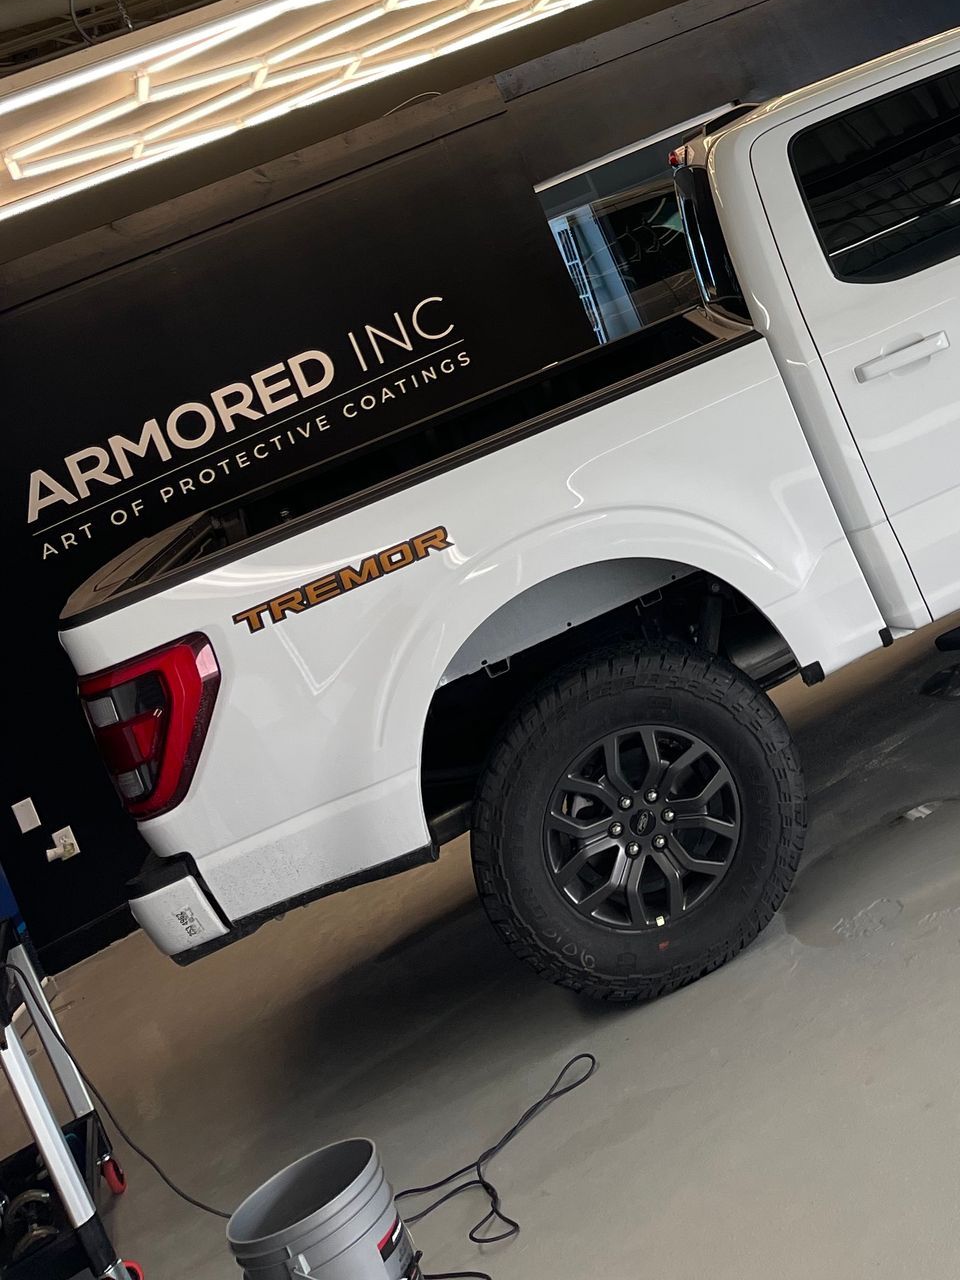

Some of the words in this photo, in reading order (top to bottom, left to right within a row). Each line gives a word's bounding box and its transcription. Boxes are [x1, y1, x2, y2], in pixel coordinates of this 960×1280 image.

[27, 349, 335, 524] ARMORED
[347, 296, 455, 372] INC
[42, 522, 93, 560] ART
[110, 498, 144, 526] OF
[159, 414, 332, 504] PROTECTIVE
[342, 351, 471, 418] COATINGS
[232, 526, 454, 634] TREMOR
